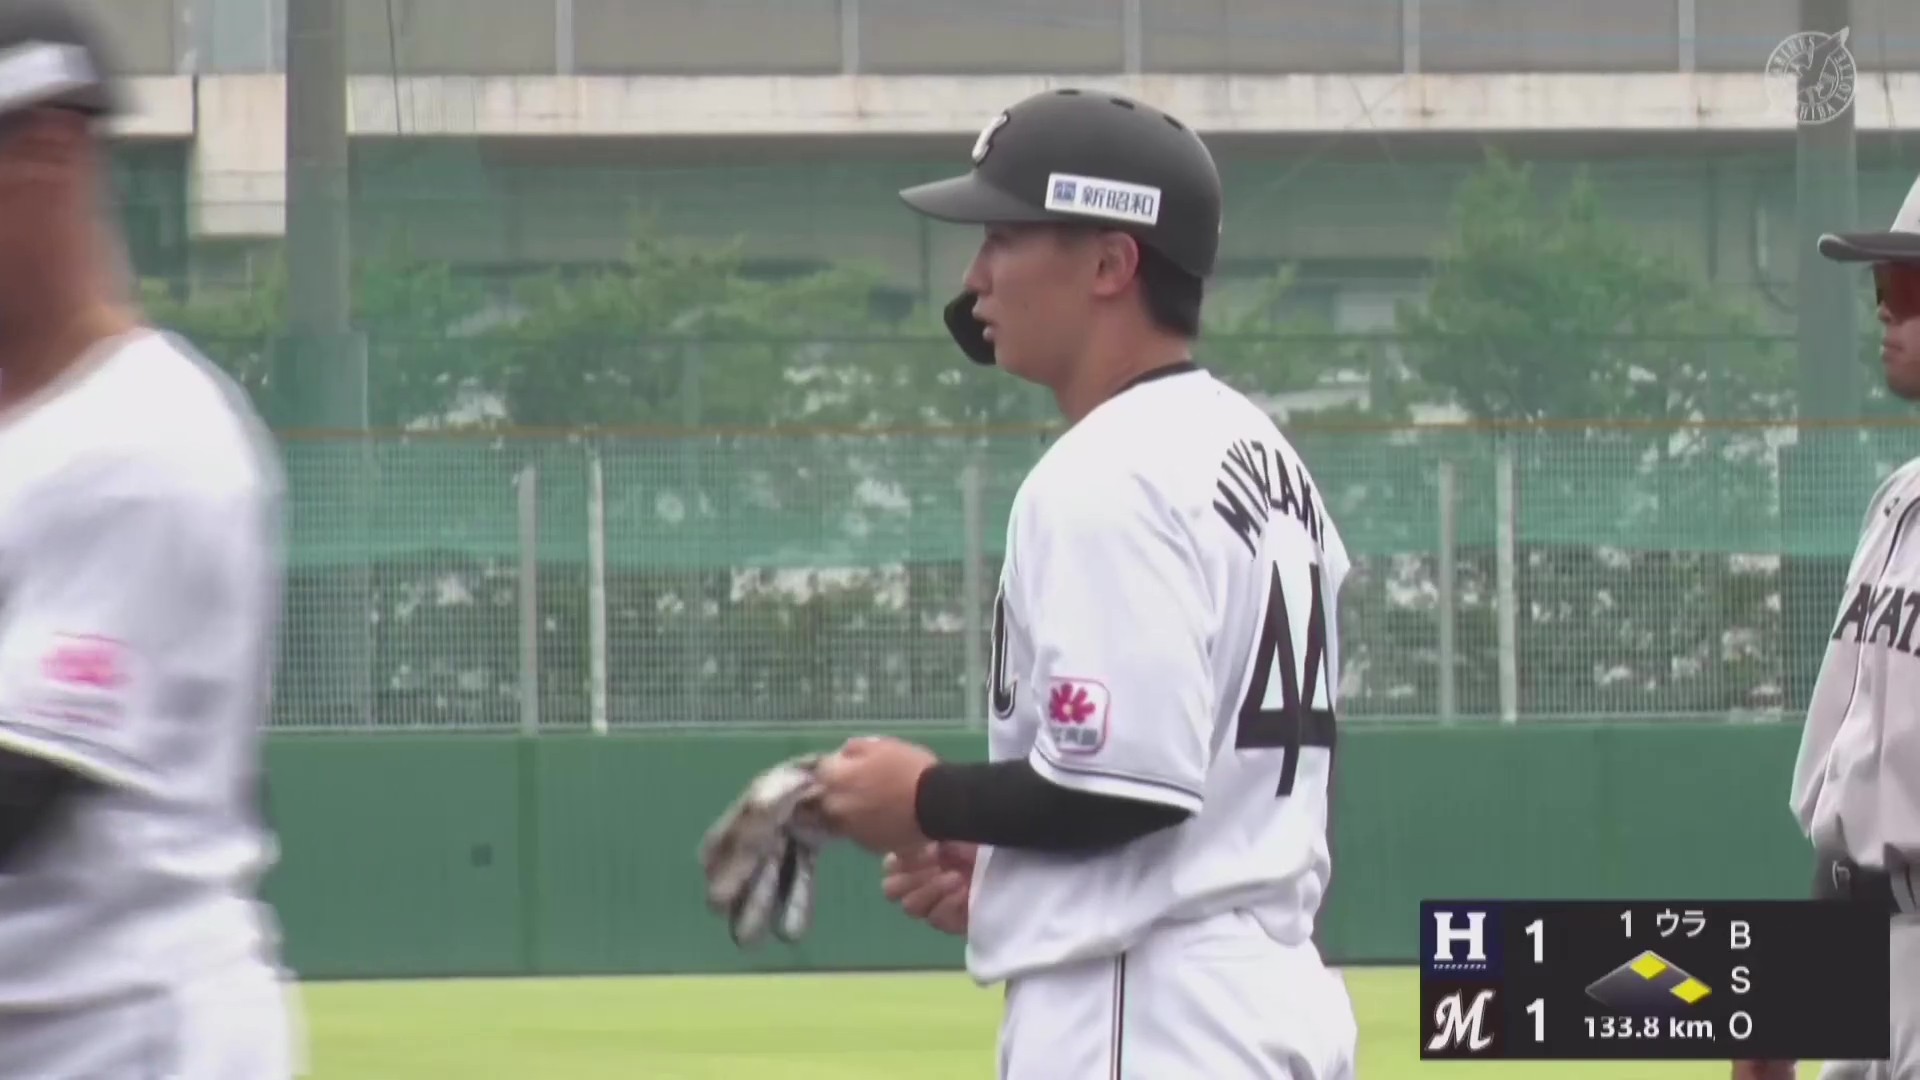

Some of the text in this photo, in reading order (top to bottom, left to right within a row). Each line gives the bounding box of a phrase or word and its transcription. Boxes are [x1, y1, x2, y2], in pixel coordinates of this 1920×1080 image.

[1081, 185, 1154, 216] 新昭和
[1235, 560, 1338, 797] 44
